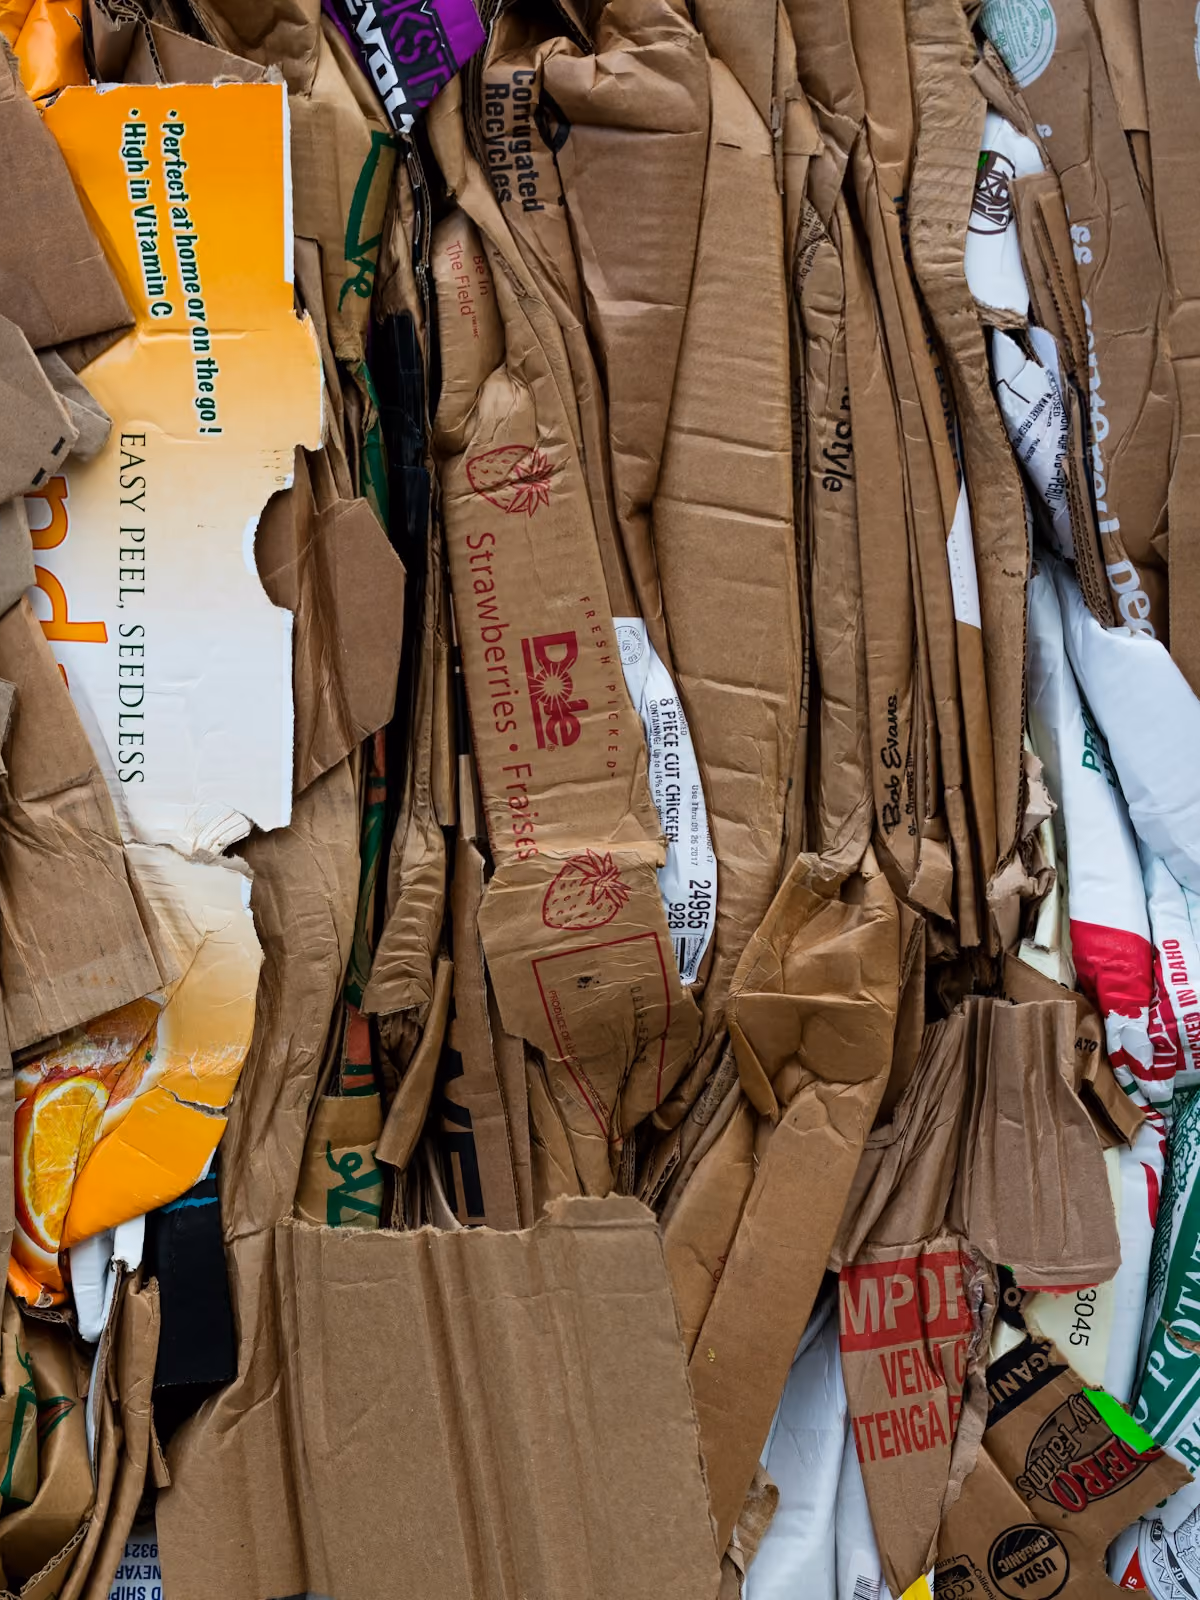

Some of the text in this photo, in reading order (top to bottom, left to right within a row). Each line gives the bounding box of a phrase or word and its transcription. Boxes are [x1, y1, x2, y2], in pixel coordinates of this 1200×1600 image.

[162, 122, 186, 202] Perfect
[511, 70, 545, 212] Corrugated
[120, 122, 173, 318] High in Vitamin C
[170, 205, 193, 231] at
[173, 233, 202, 296] home
[445, 240, 464, 273] The
[185, 298, 206, 323] or
[454, 273, 479, 316] Field
[191, 327, 211, 352] on
[196, 356, 220, 394] the
[116, 432, 146, 783] EASY PEEL, SEEDLESS
[466, 532, 539, 860] Strawberries Fraises
[579, 596, 617, 768] FRESH PICKED
[661, 711, 679, 748] PIECE
[664, 753, 680, 779] CUT
[880, 694, 902, 835] Bob Evans
[665, 784, 681, 843] CHICKEN
[668, 902, 686, 930] 928
[688, 879, 711, 930] 24955
[1162, 939, 1189, 986] IDAHO
[1175, 988, 1197, 1009] IN
[997, 1534, 1050, 1574] ORGANIC
[1012, 1557, 1058, 1589] USDA
